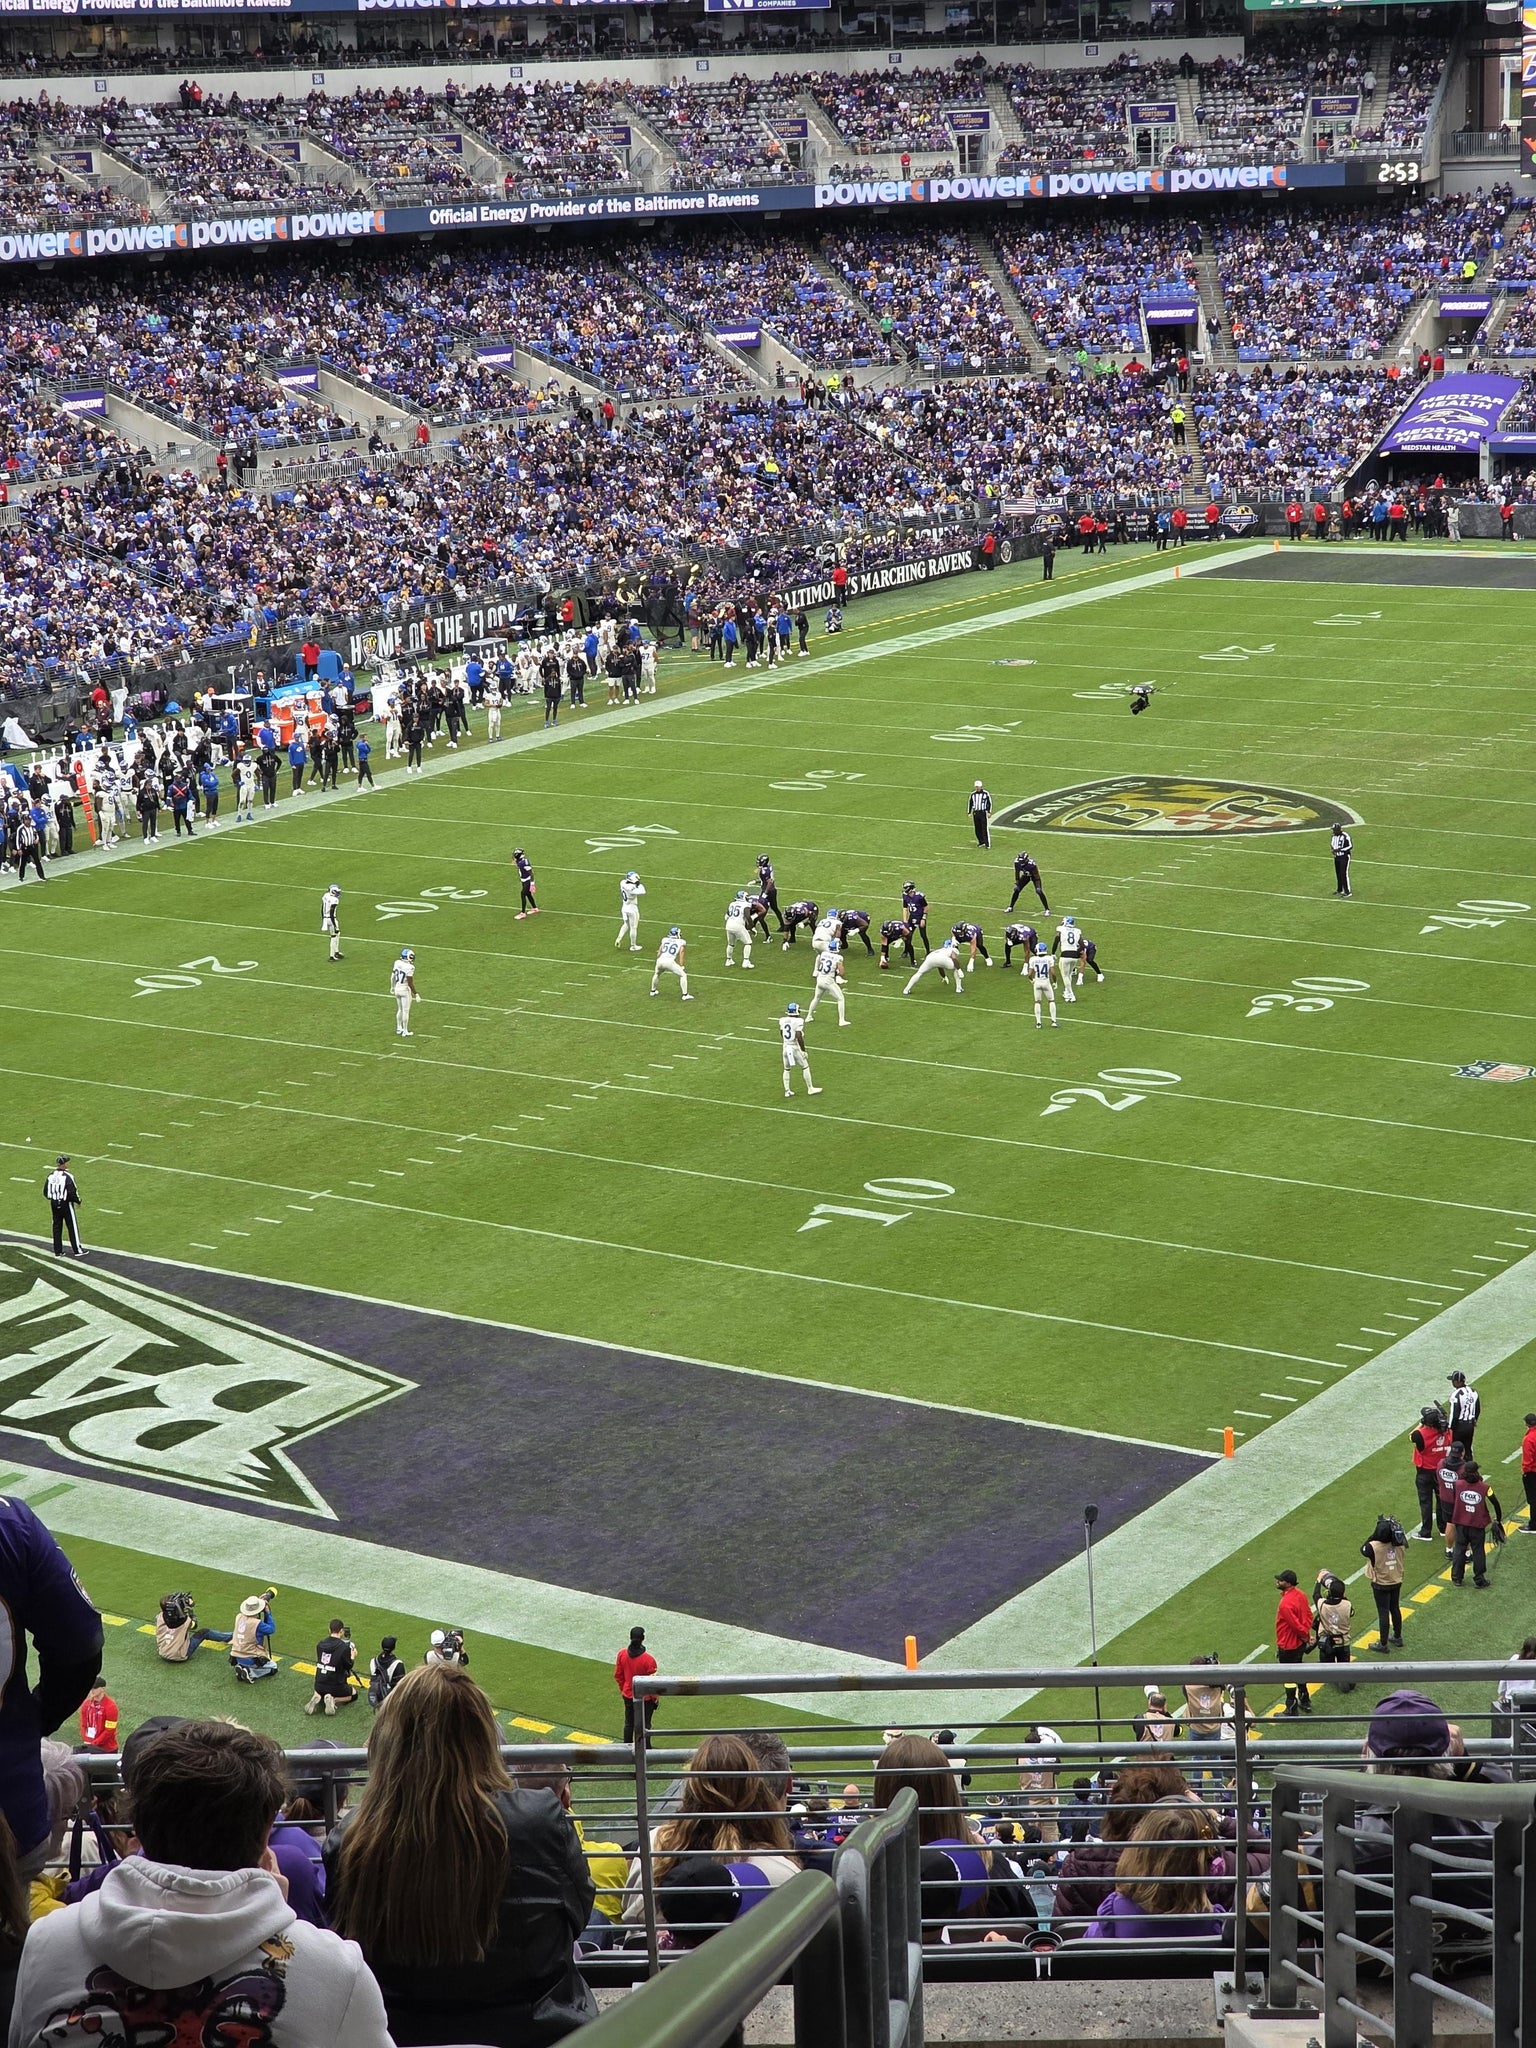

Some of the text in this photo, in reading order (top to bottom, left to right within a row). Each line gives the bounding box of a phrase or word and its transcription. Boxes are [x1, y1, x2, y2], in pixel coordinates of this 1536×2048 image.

[1378, 162, 1419, 183] 2:53
[429, 192, 760, 225] Official Energy Provider of the Baltimore Ravens
[0, 232, 69, 261] ower
[1418, 393, 1505, 406] MEDSTAR
[1421, 400, 1493, 411] HEALTH
[1392, 426, 1481, 440] MEDSTAR
[1396, 433, 1469, 445] HEALTH
[860, 562, 927, 593] MARCHING
[928, 550, 973, 577] RAVENS
[434, 613, 465, 648] THE
[1013, 780, 1148, 824] RAVENS
[1067, 931, 1075, 945] 8
[661, 942, 679, 956] 56
[1034, 963, 1049, 979] 14
[784, 1023, 792, 1040] 3
[1464, 1492, 1477, 1500] FOX
